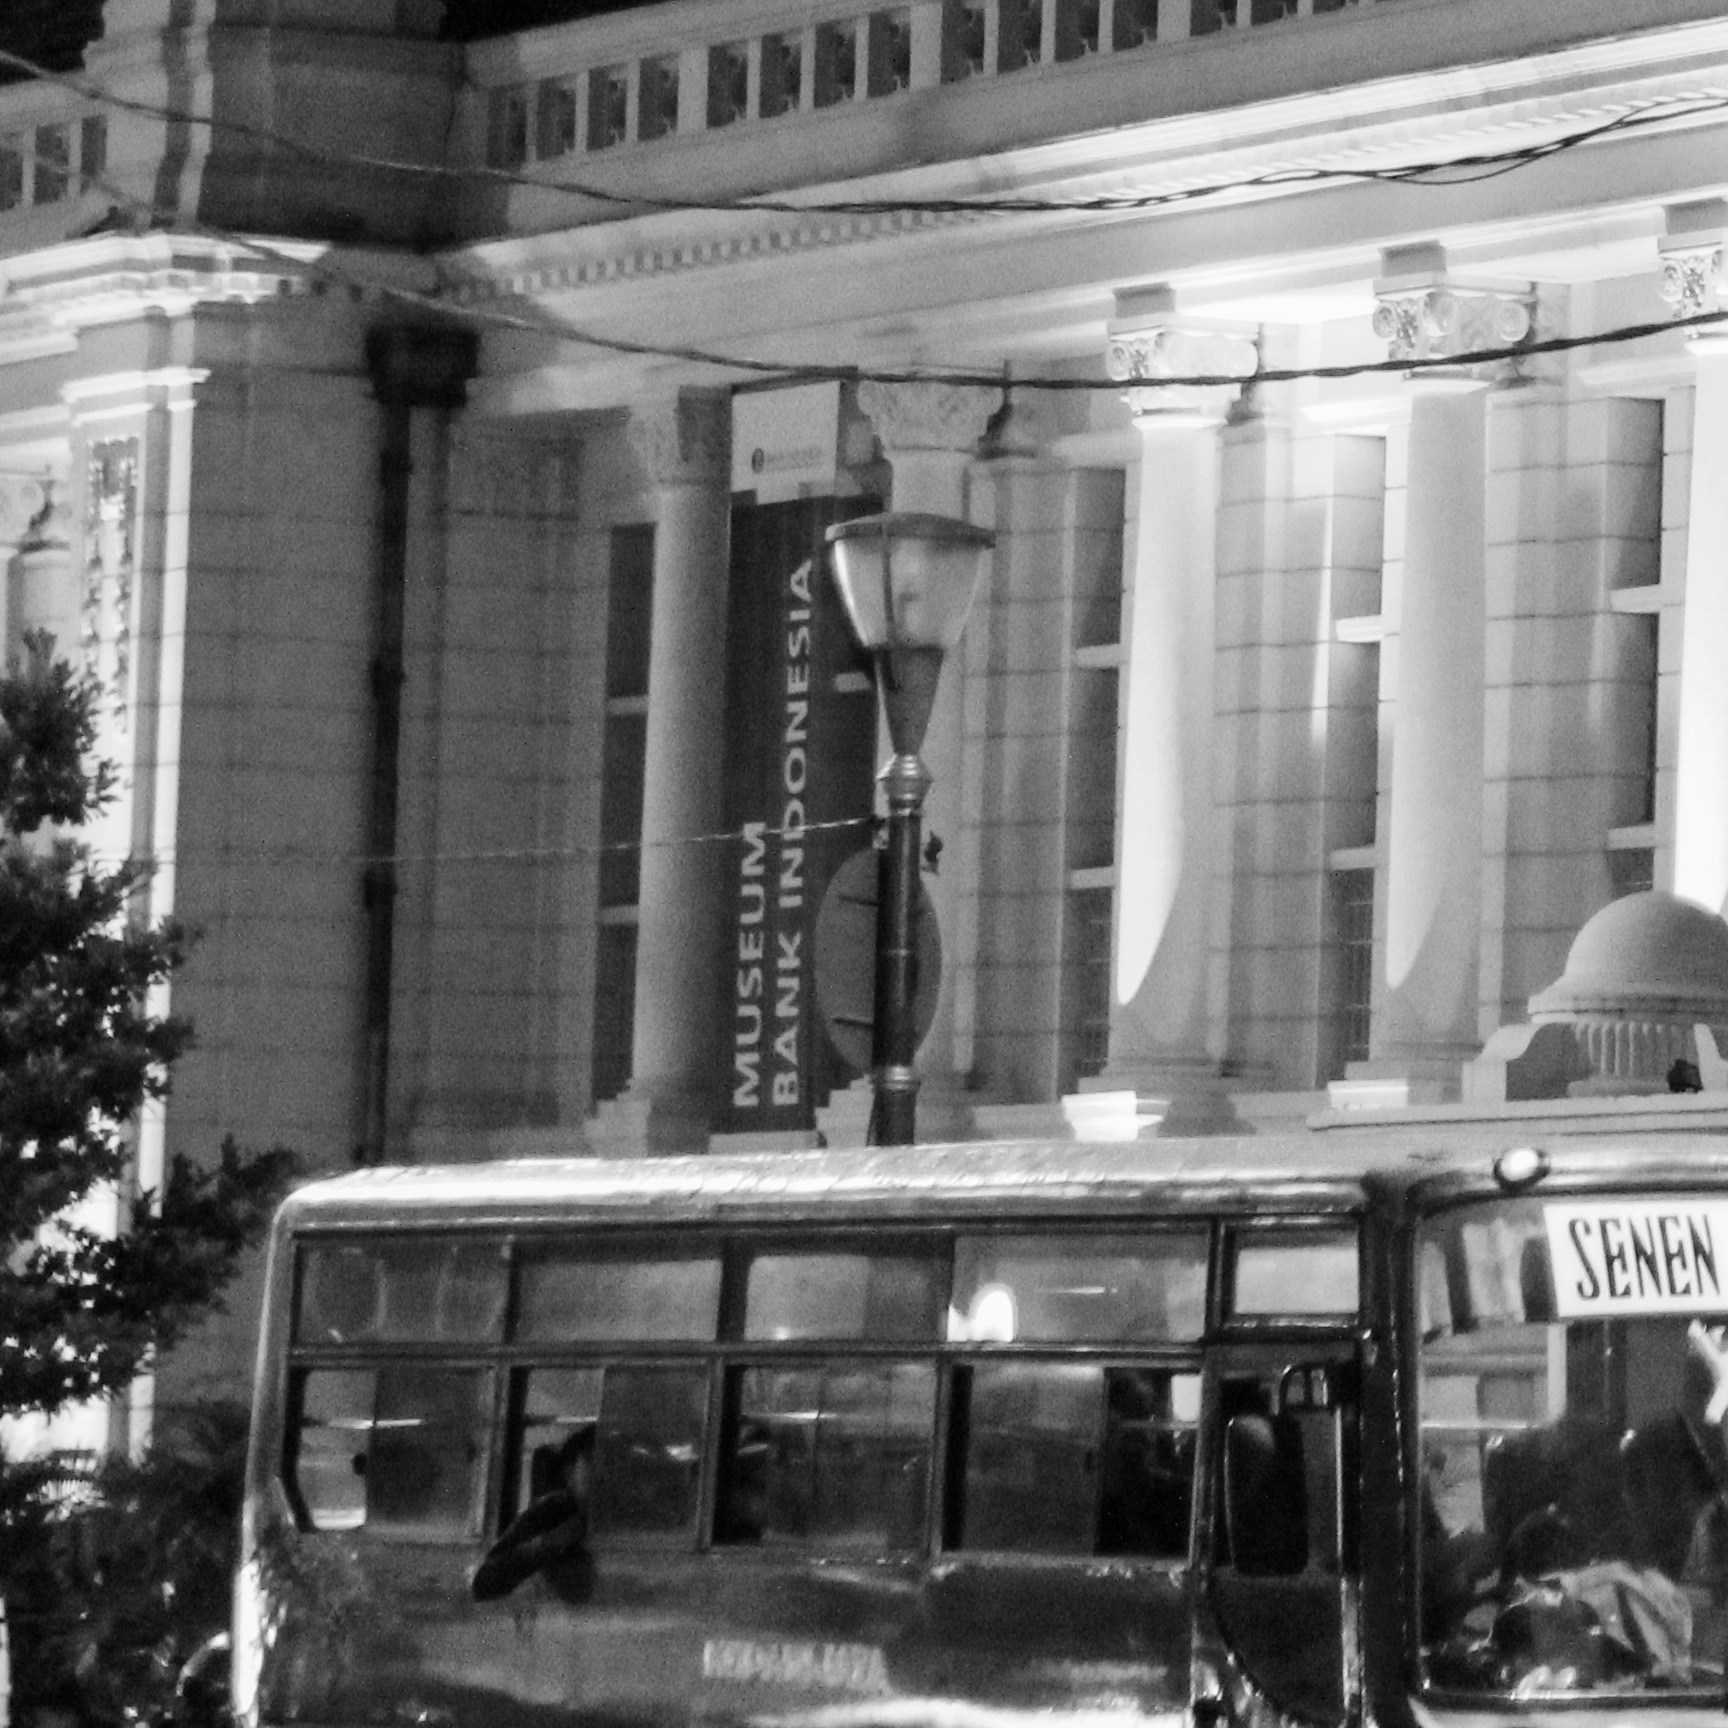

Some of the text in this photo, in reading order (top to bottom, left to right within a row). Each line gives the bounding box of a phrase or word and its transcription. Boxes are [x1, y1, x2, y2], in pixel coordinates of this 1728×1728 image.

[733, 821, 769, 1107] MUSEUM
[772, 557, 813, 1106] BANK INDONESIA
[1568, 1213, 1721, 1300] SENEN
